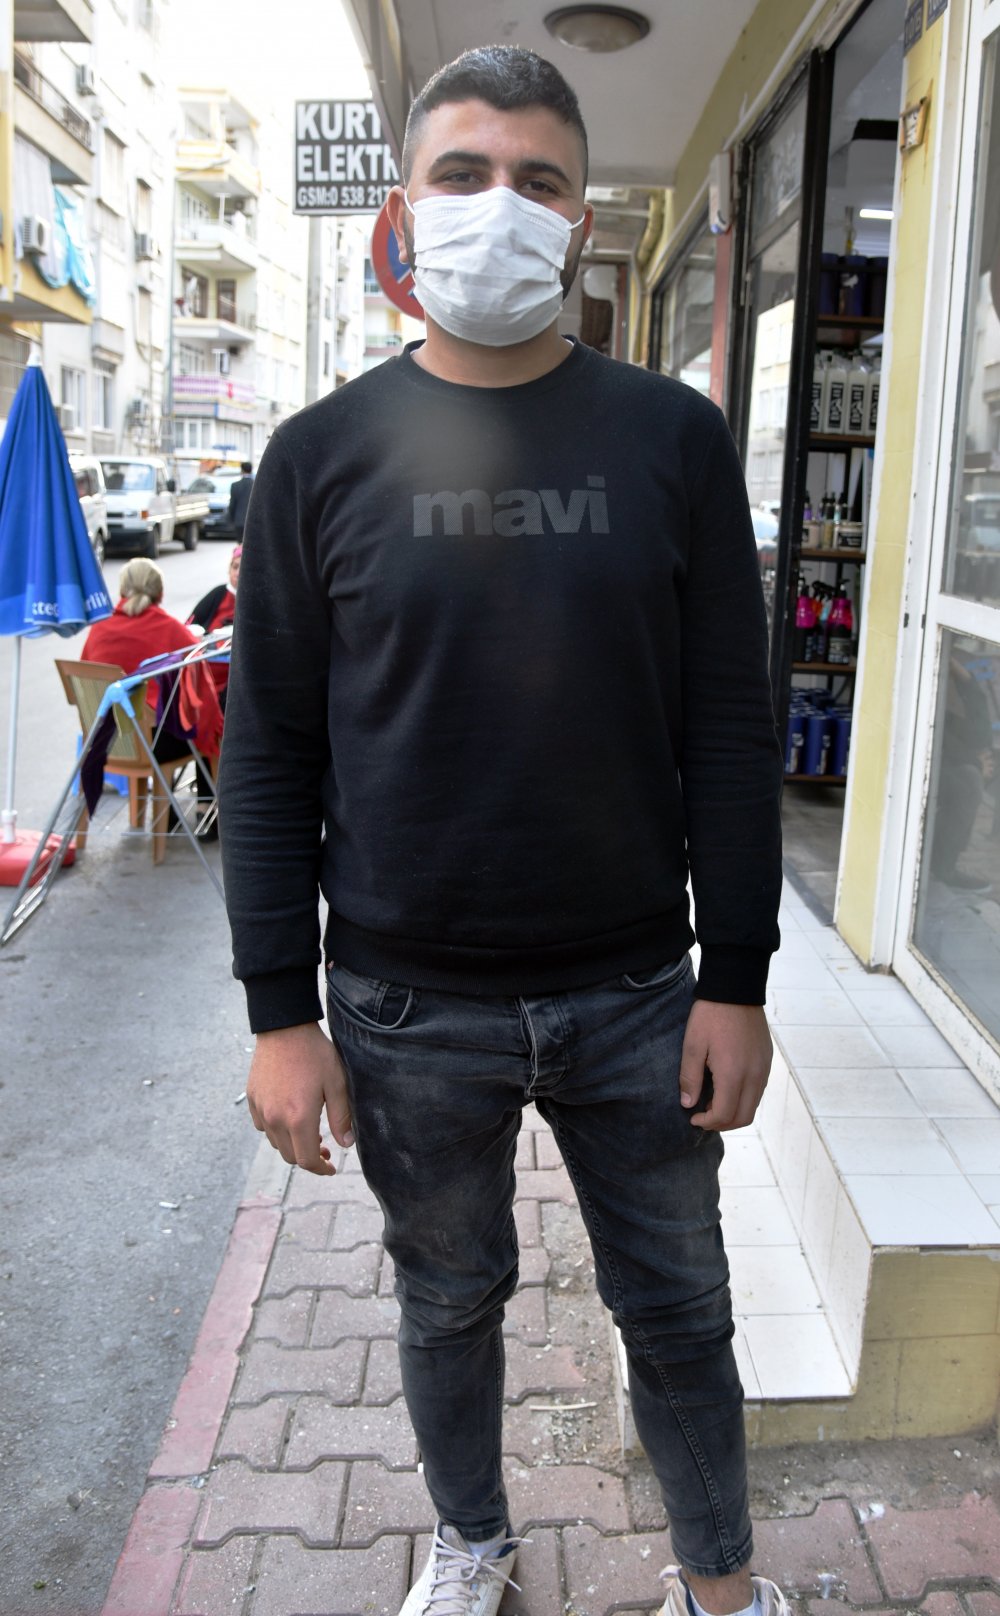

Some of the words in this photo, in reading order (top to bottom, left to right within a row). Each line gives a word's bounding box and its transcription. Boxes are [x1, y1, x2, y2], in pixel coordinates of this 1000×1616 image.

[297, 103, 381, 140] KURT
[341, 186, 365, 206] 538
[413, 475, 610, 537] mavi
